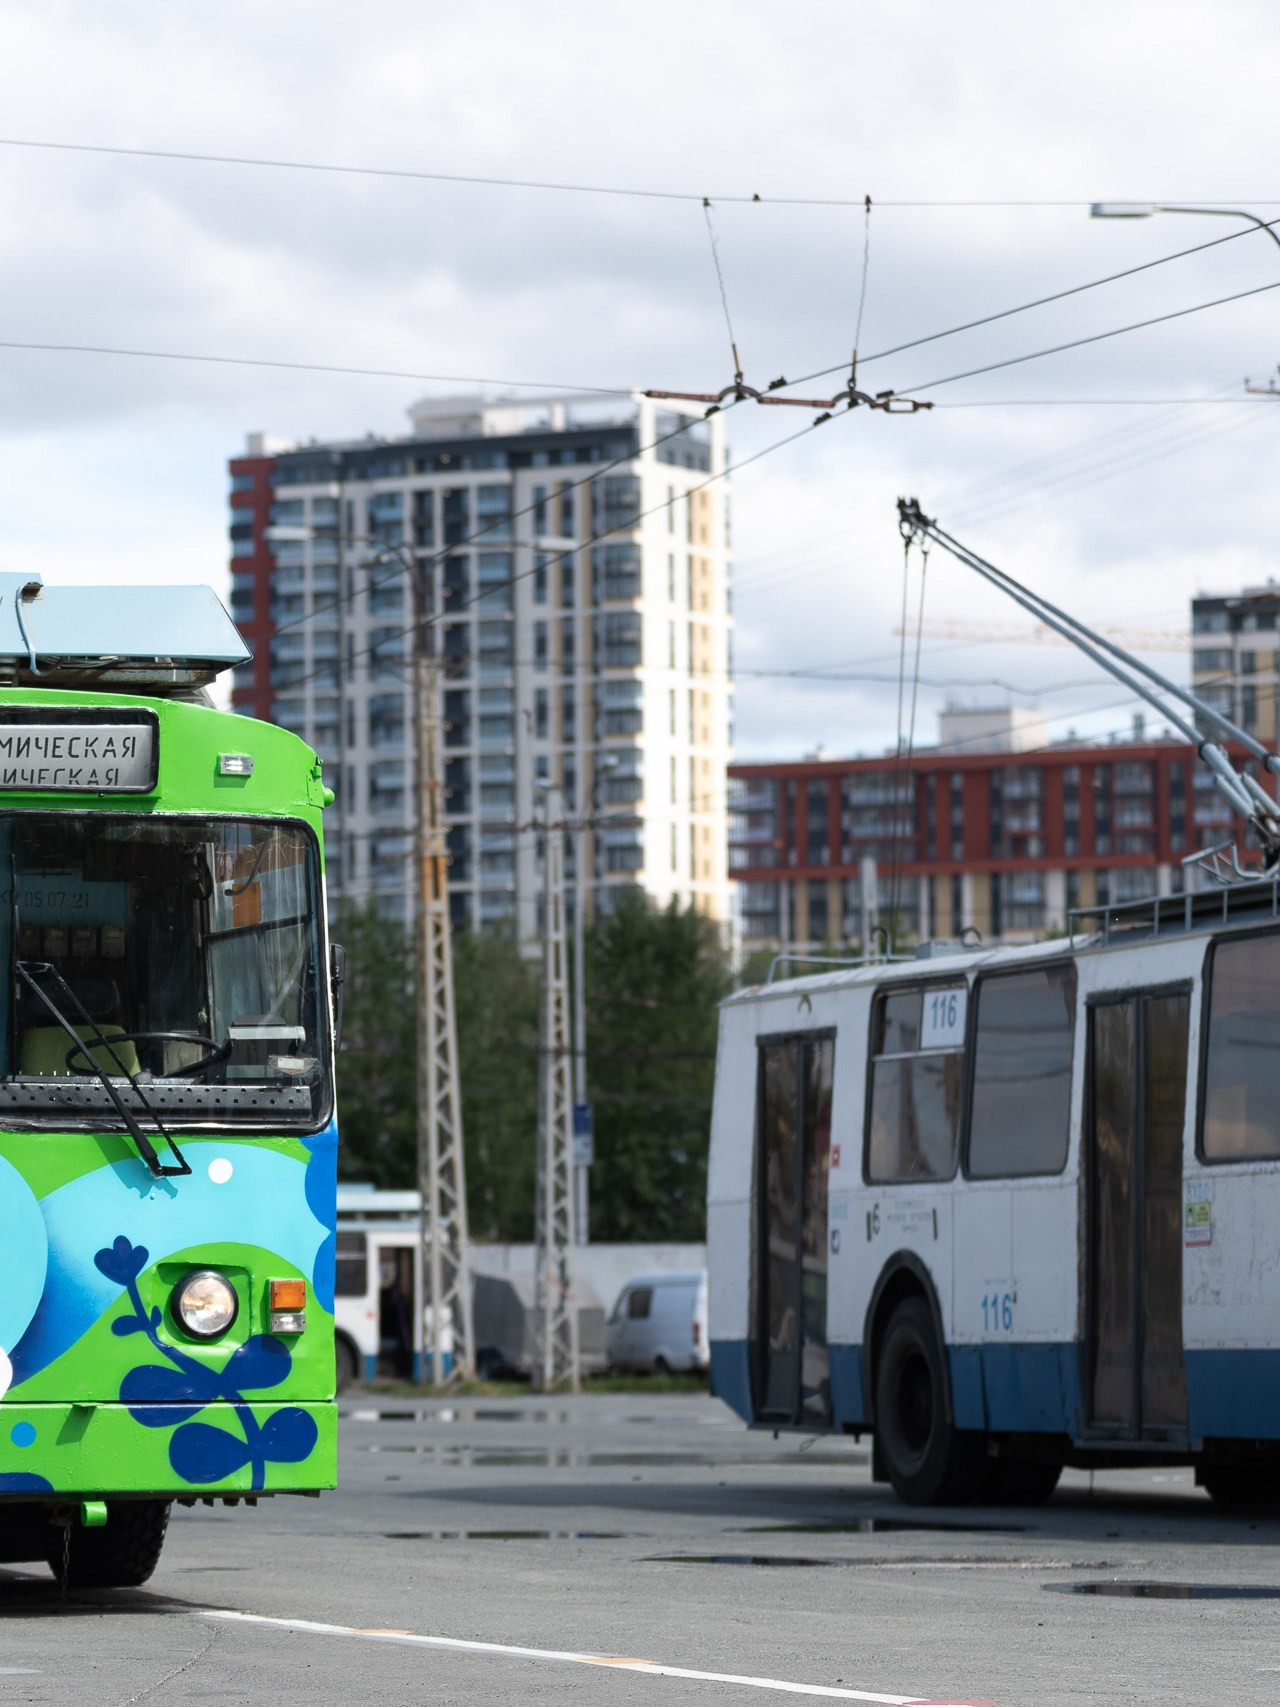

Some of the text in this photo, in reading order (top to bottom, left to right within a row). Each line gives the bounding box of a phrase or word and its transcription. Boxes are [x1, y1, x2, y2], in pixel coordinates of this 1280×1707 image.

[24, 890, 43, 908] 05
[47, 891, 66, 908] 07
[73, 892, 89, 909] 21
[931, 994, 957, 1029] 116
[981, 1293, 1013, 1332] 116
